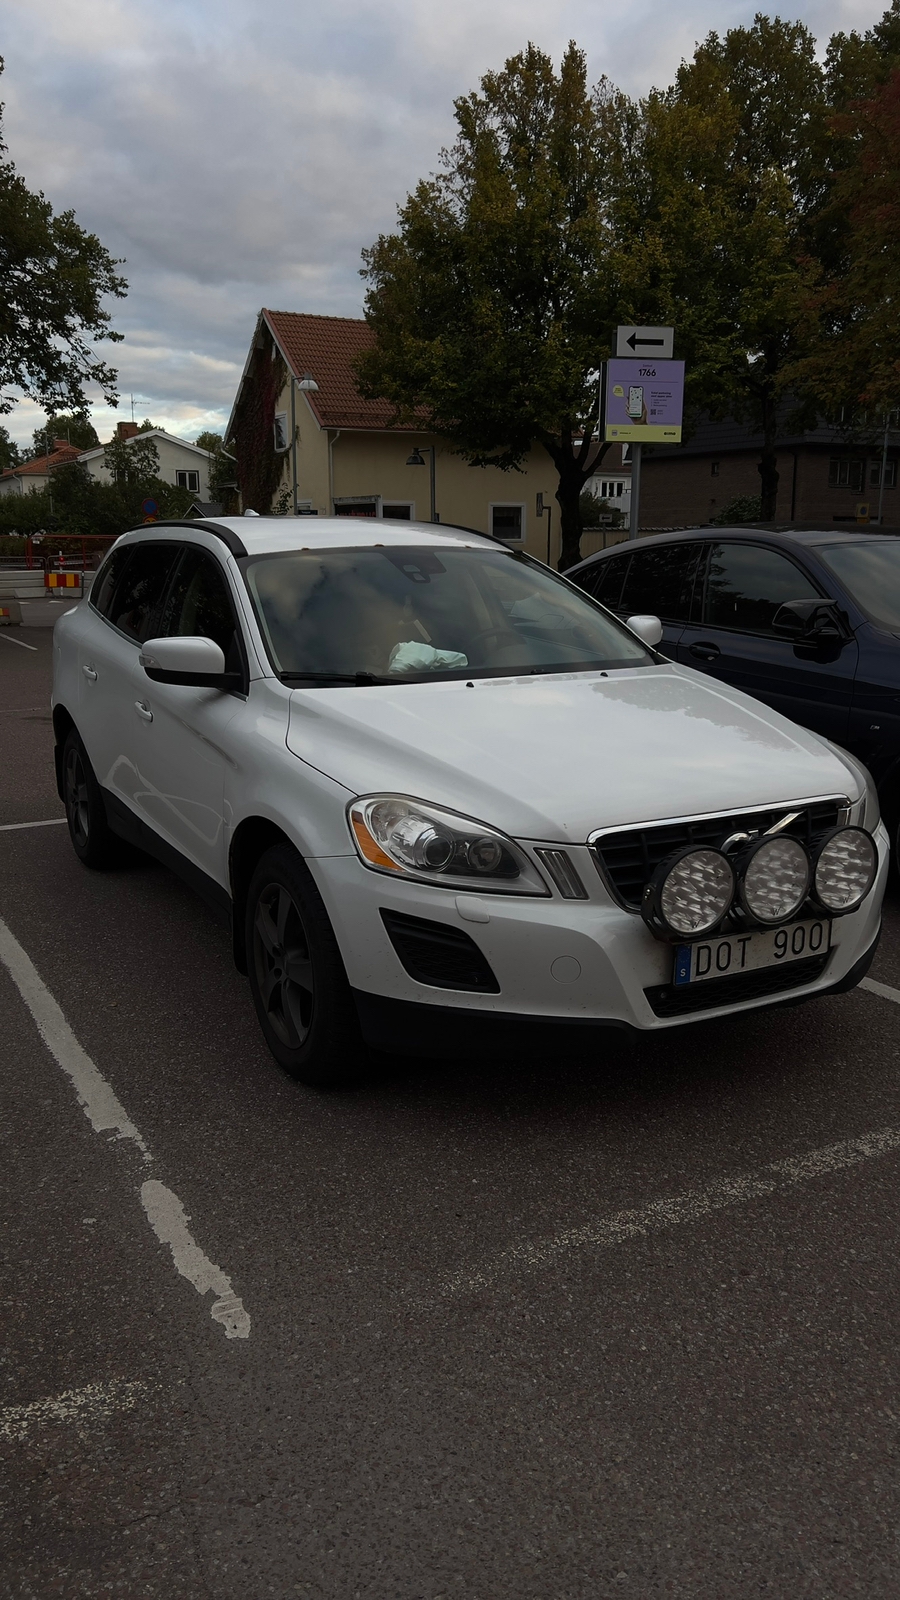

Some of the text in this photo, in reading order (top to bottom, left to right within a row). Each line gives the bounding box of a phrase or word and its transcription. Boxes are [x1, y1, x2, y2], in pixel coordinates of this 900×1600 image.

[638, 368, 656, 376] 1766
[696, 922, 823, 976] DOT 900
[680, 968, 686, 977] S
